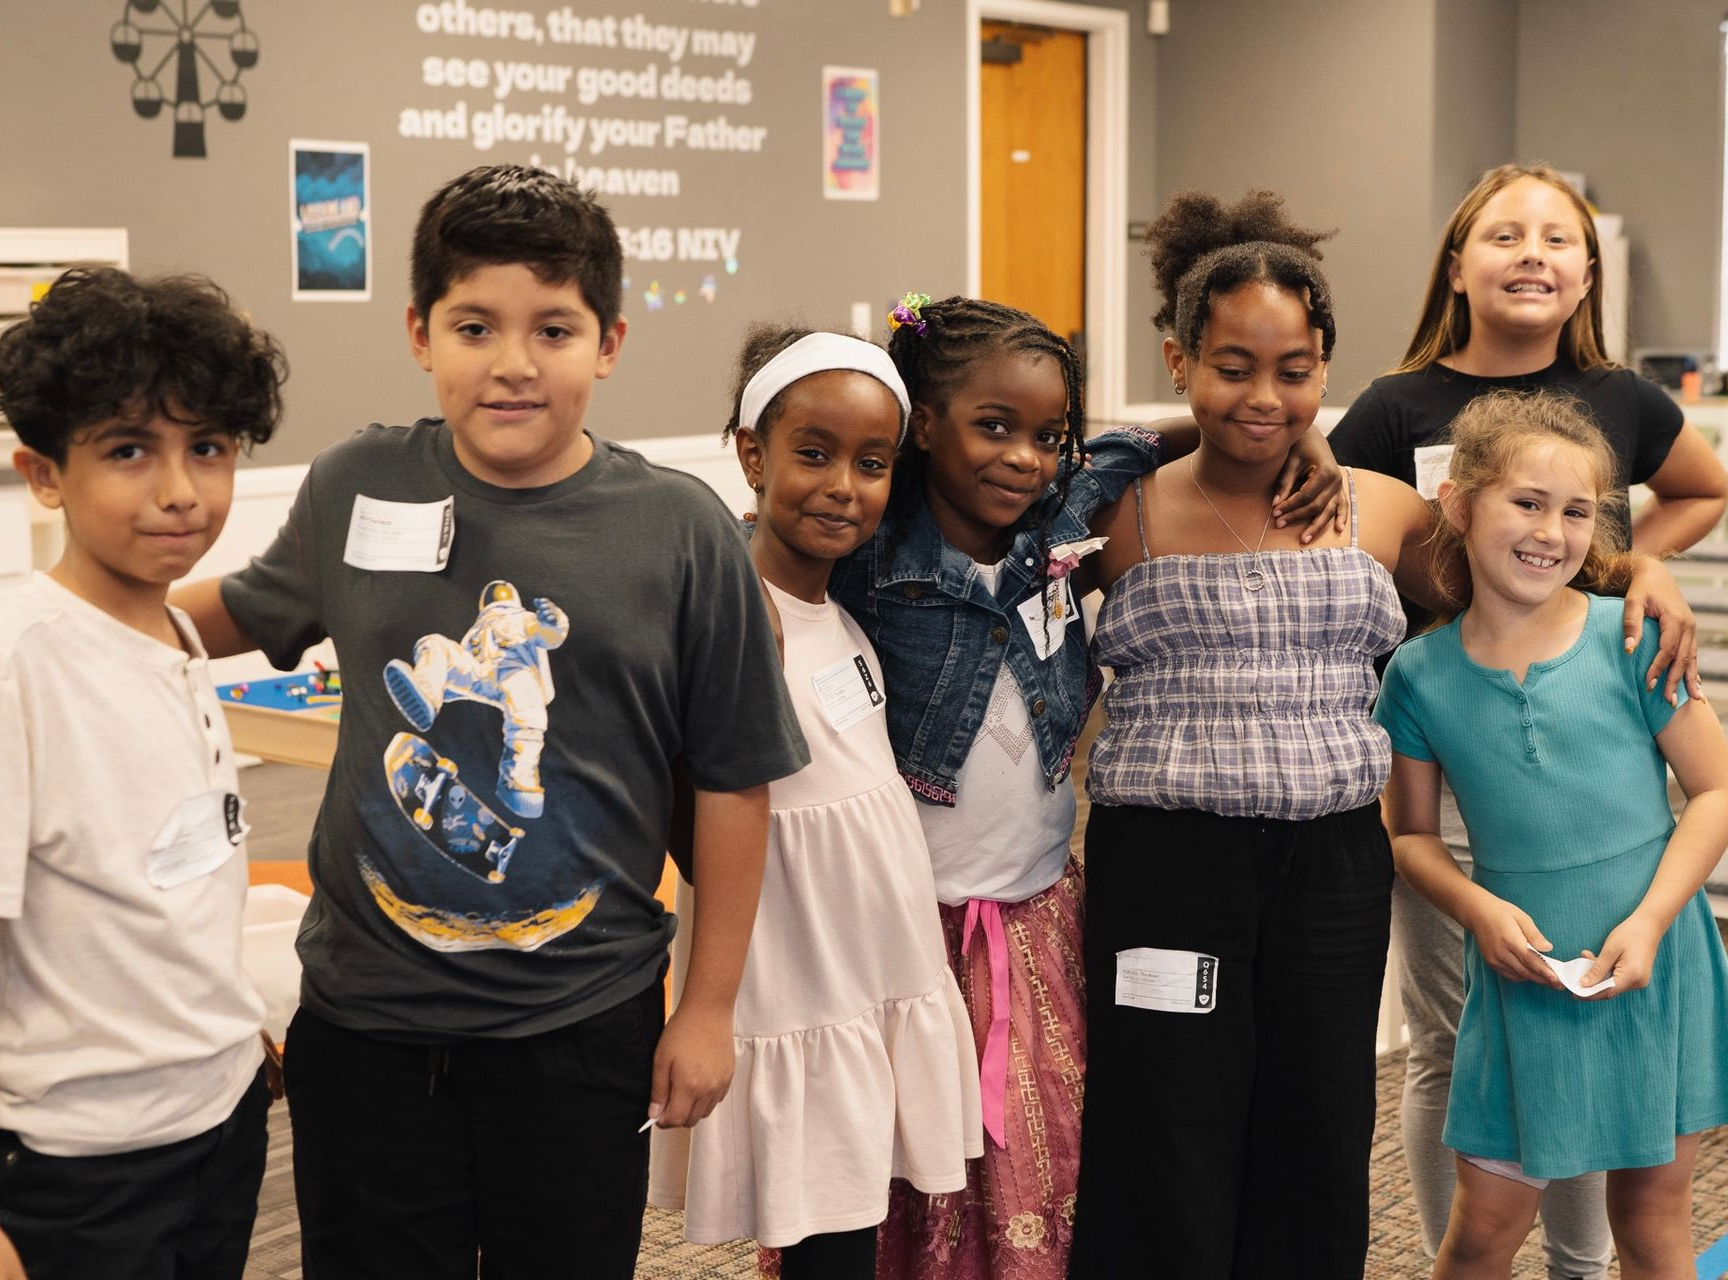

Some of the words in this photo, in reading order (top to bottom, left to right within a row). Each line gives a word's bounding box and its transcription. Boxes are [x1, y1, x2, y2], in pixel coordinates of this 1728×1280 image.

[416, 0, 544, 44] others,
[546, 10, 618, 47] that
[620, 14, 689, 62] they
[691, 30, 756, 66] may
[422, 56, 490, 88] see
[493, 60, 573, 99] your
[576, 64, 658, 104] good
[660, 68, 753, 105] deeds
[398, 101, 468, 138] and
[471, 104, 587, 153] glorify
[588, 118, 662, 154] your
[664, 115, 768, 152] Father
[564, 156, 681, 196] heaven
[677, 228, 742, 261] NIV
